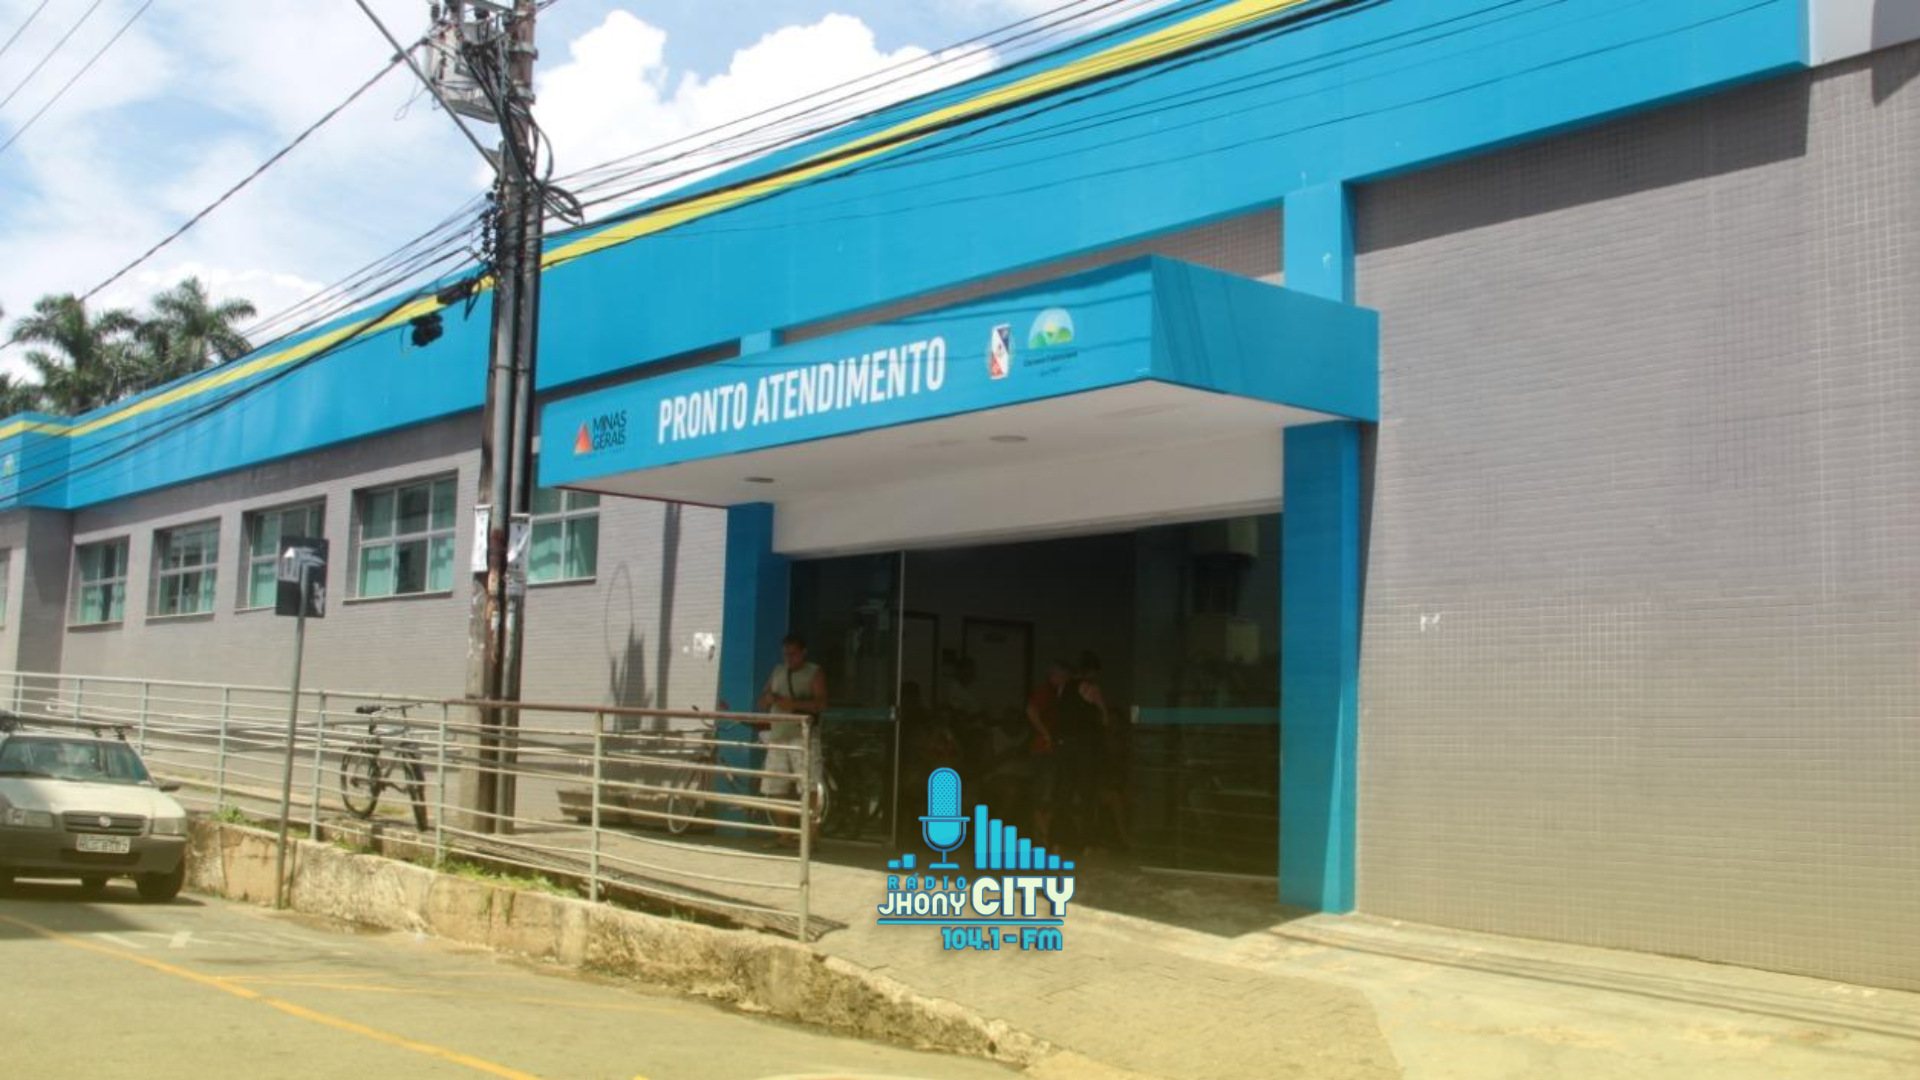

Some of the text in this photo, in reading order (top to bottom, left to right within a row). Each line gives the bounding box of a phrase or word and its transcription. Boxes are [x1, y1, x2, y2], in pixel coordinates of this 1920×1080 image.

[658, 336, 946, 445] PRONTO ATENDIMENTO
[592, 409, 627, 432] MINAS
[592, 429, 626, 451] GERAIS
